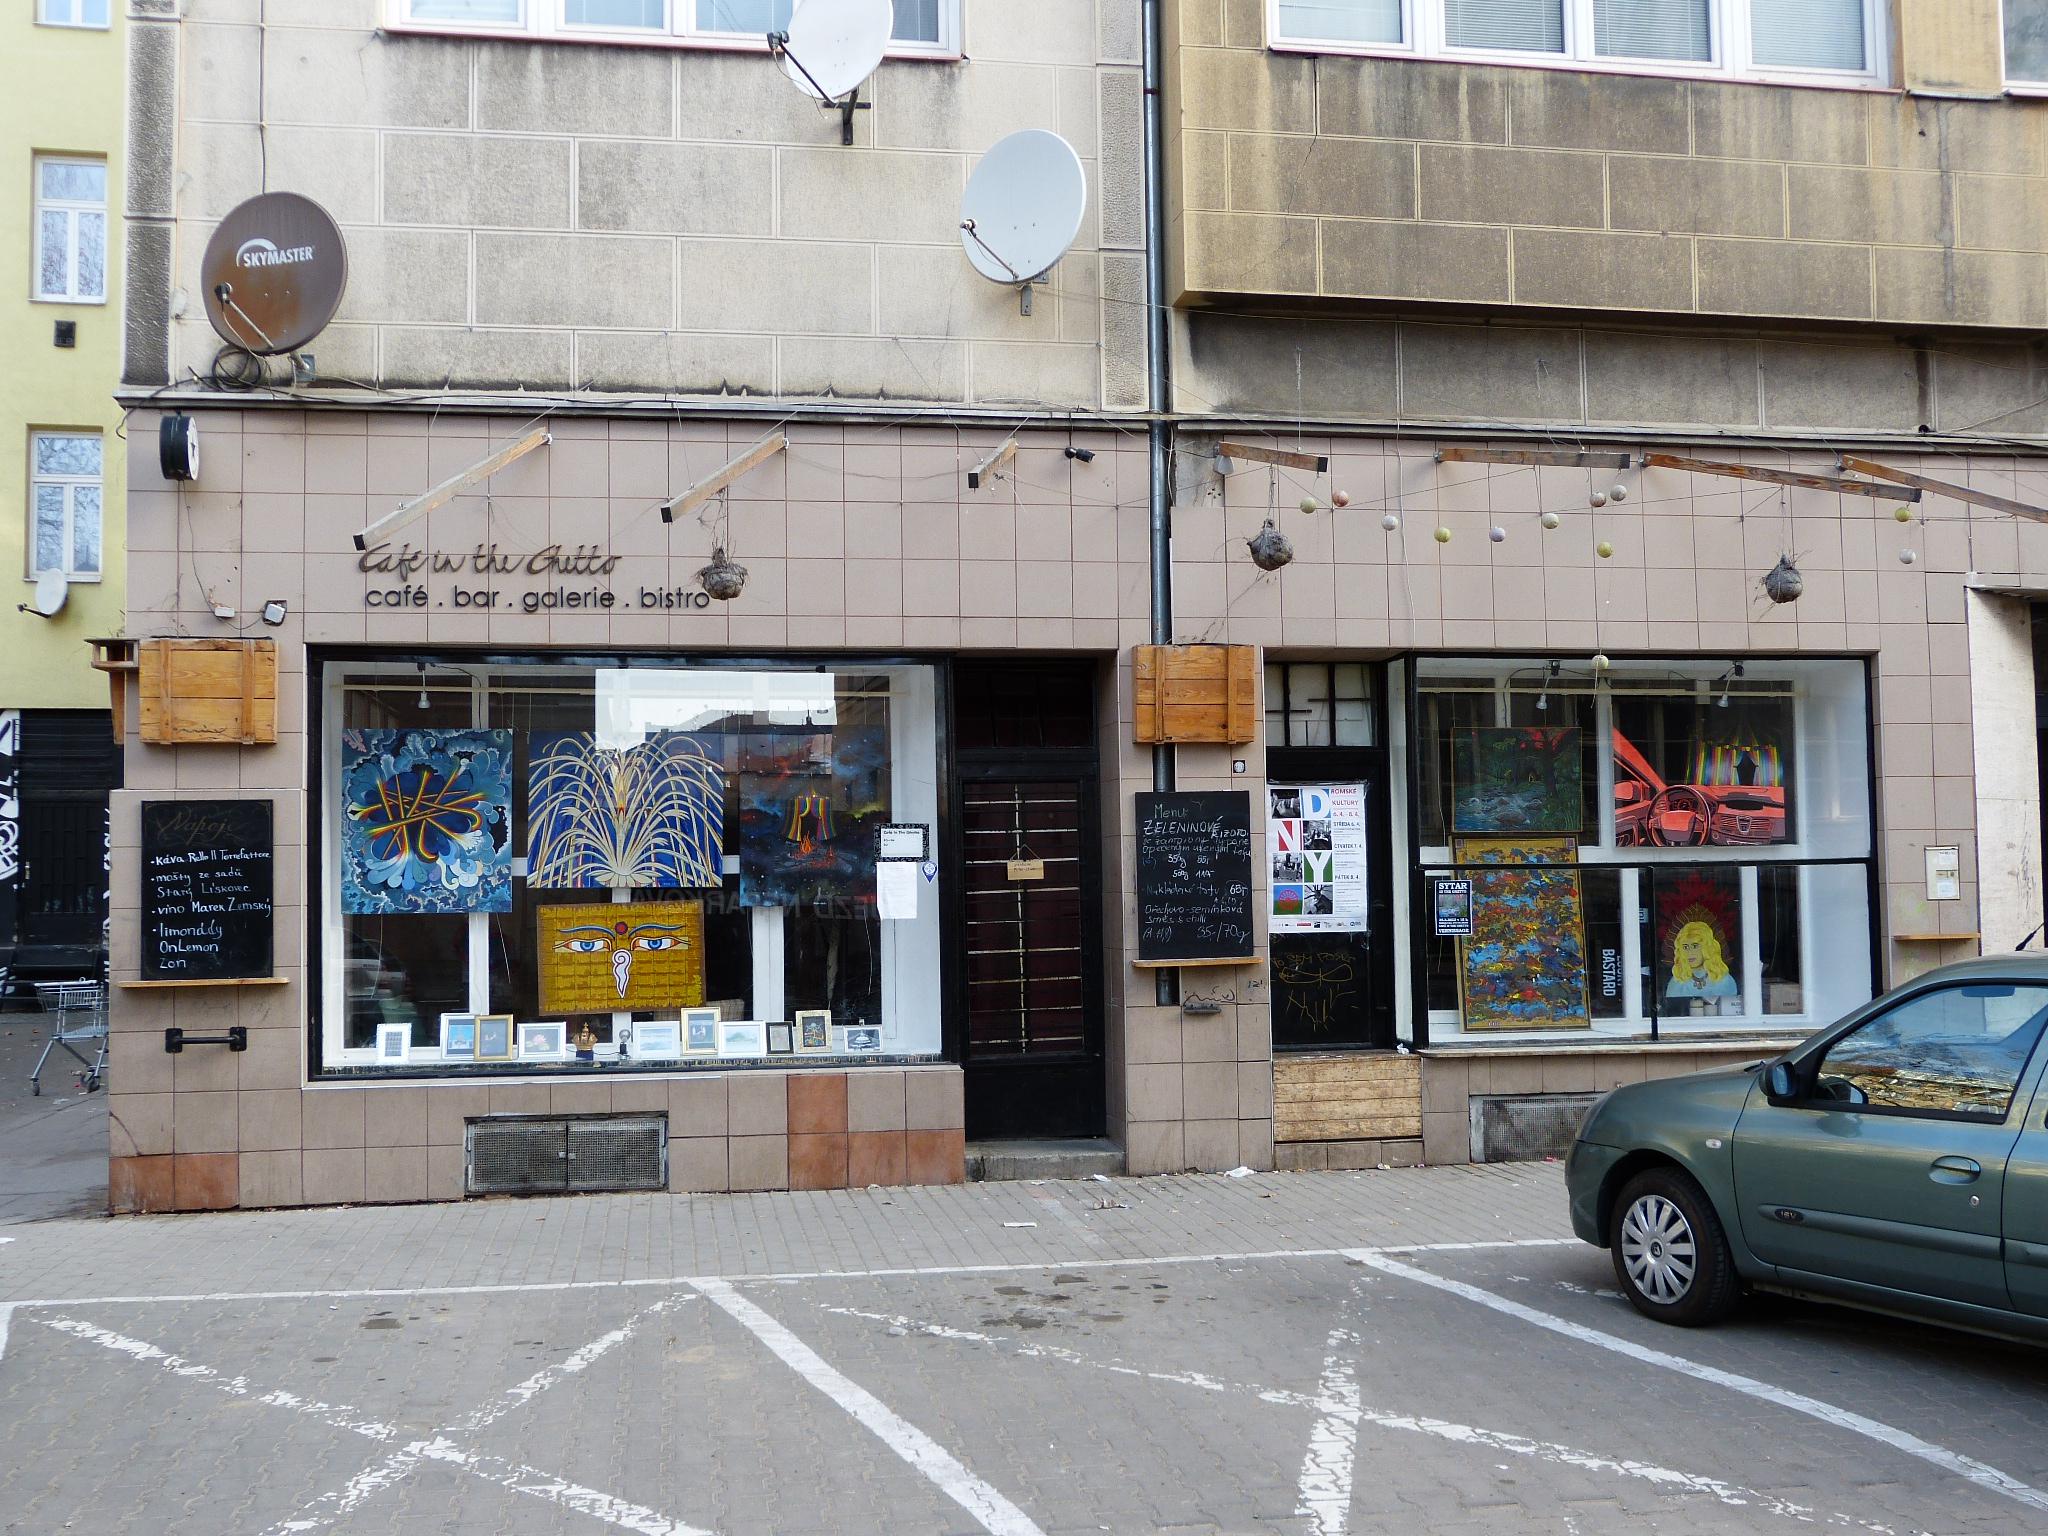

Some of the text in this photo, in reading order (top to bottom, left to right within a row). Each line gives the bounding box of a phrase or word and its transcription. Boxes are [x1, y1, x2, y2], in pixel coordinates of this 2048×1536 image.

[243, 246, 313, 267] SKYMASTER
[433, 549, 465, 574] in
[472, 543, 524, 575] the
[365, 585, 428, 607] café
[454, 585, 500, 608] bar
[522, 585, 615, 613] galerie
[641, 586, 710, 609] bistro
[1438, 882, 1468, 890] SYTAR
[1602, 949, 1616, 996] BASTARD
